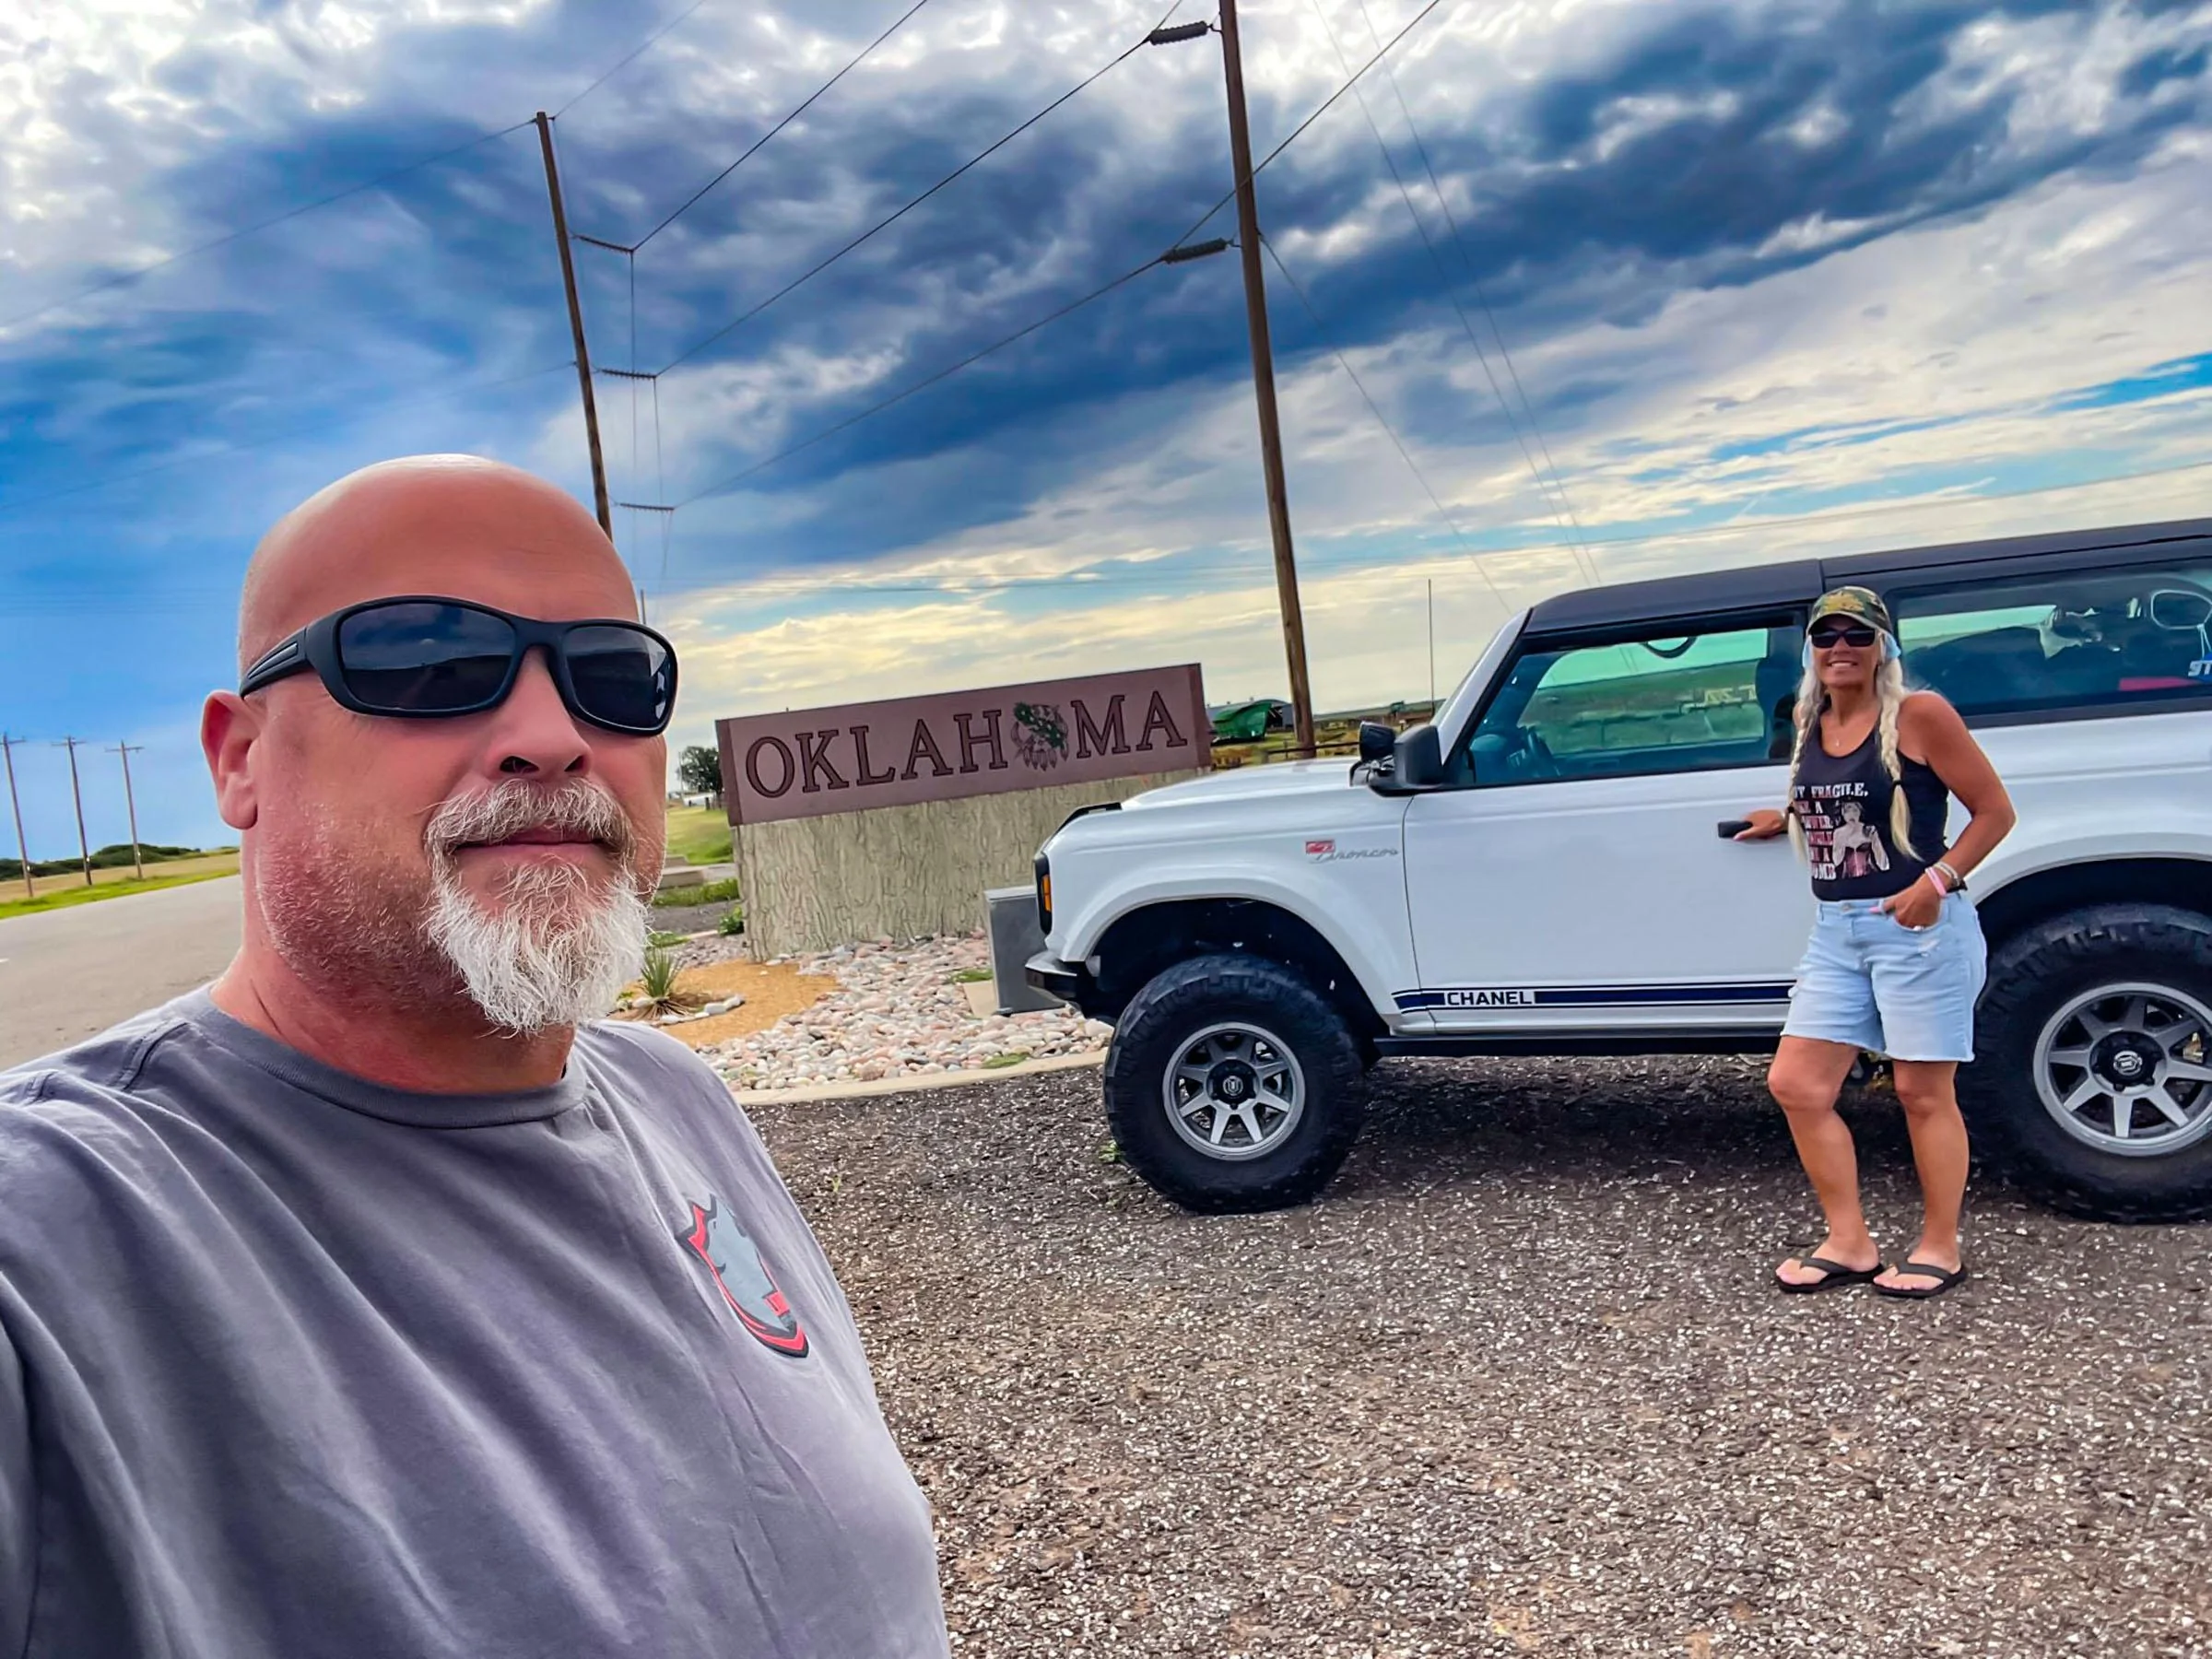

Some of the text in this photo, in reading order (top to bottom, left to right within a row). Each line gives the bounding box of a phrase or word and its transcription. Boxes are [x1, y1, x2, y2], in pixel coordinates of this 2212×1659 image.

[746, 691, 1187, 798] OKLAHMA
[1811, 782, 1869, 798] FRAGILE,
[1447, 990, 1533, 1006] CHANEL
